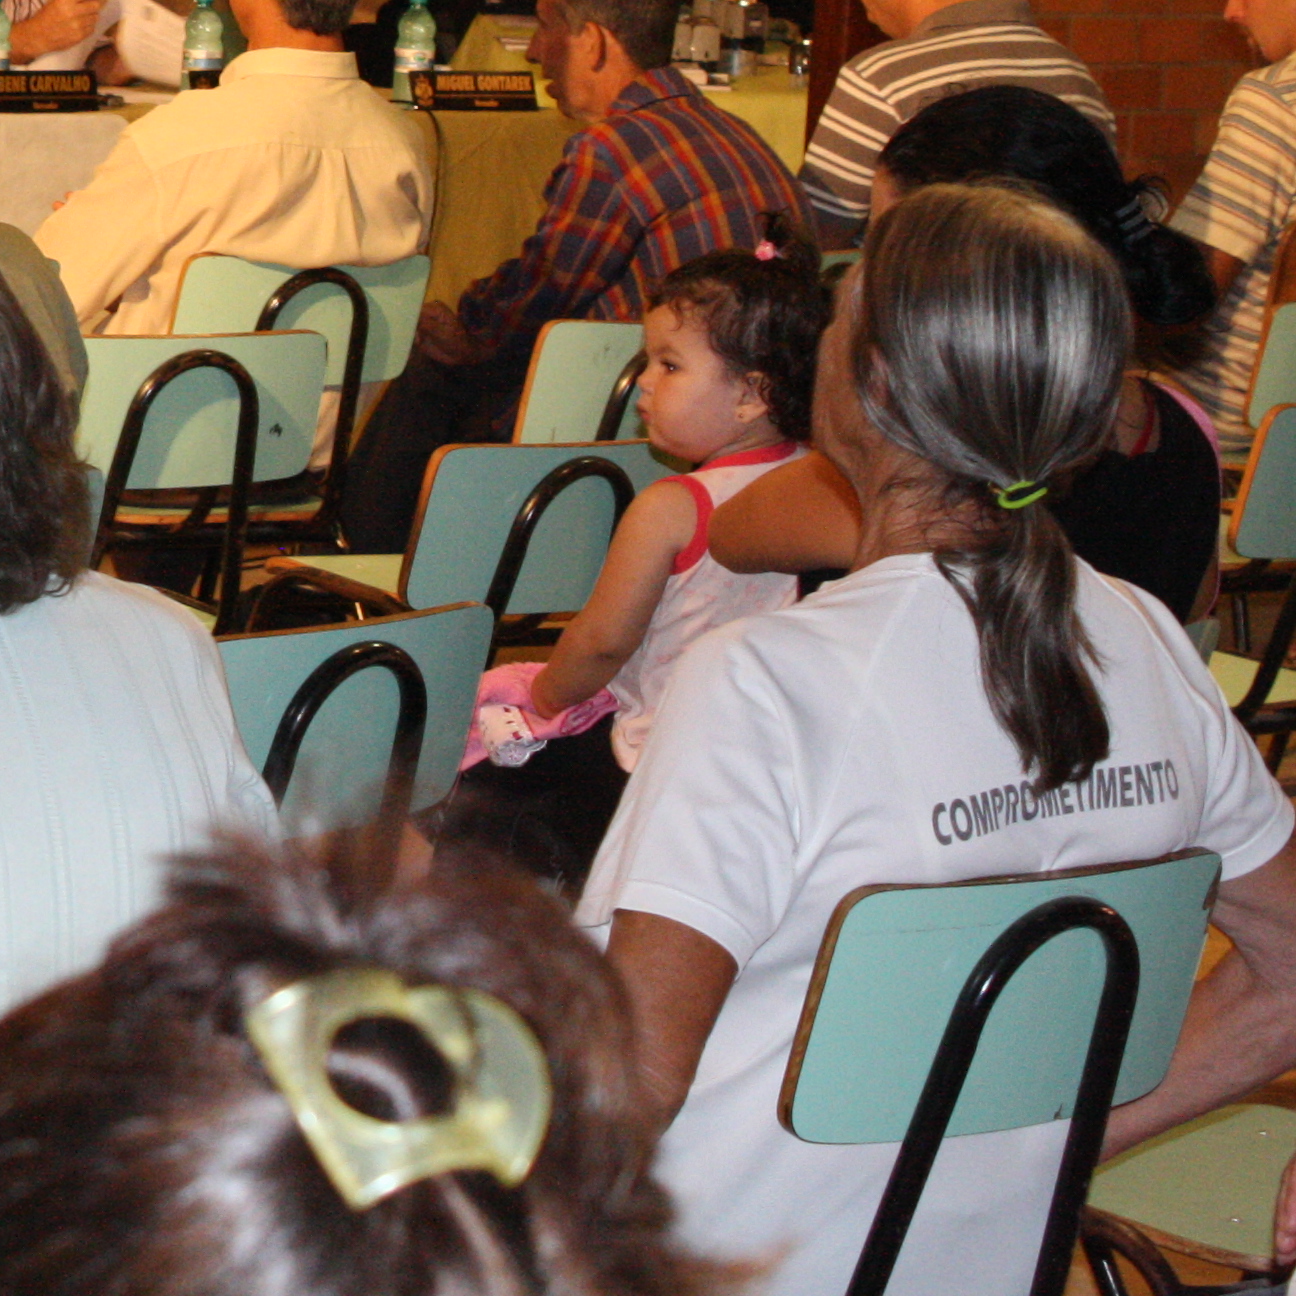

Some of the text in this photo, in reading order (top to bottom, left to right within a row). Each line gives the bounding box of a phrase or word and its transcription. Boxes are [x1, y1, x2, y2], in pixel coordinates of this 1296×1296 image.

[29, 75, 91, 93] CARVALHO
[436, 75, 475, 91] MIGUEL
[931, 758, 1180, 847] COMPROMETIMENTO
